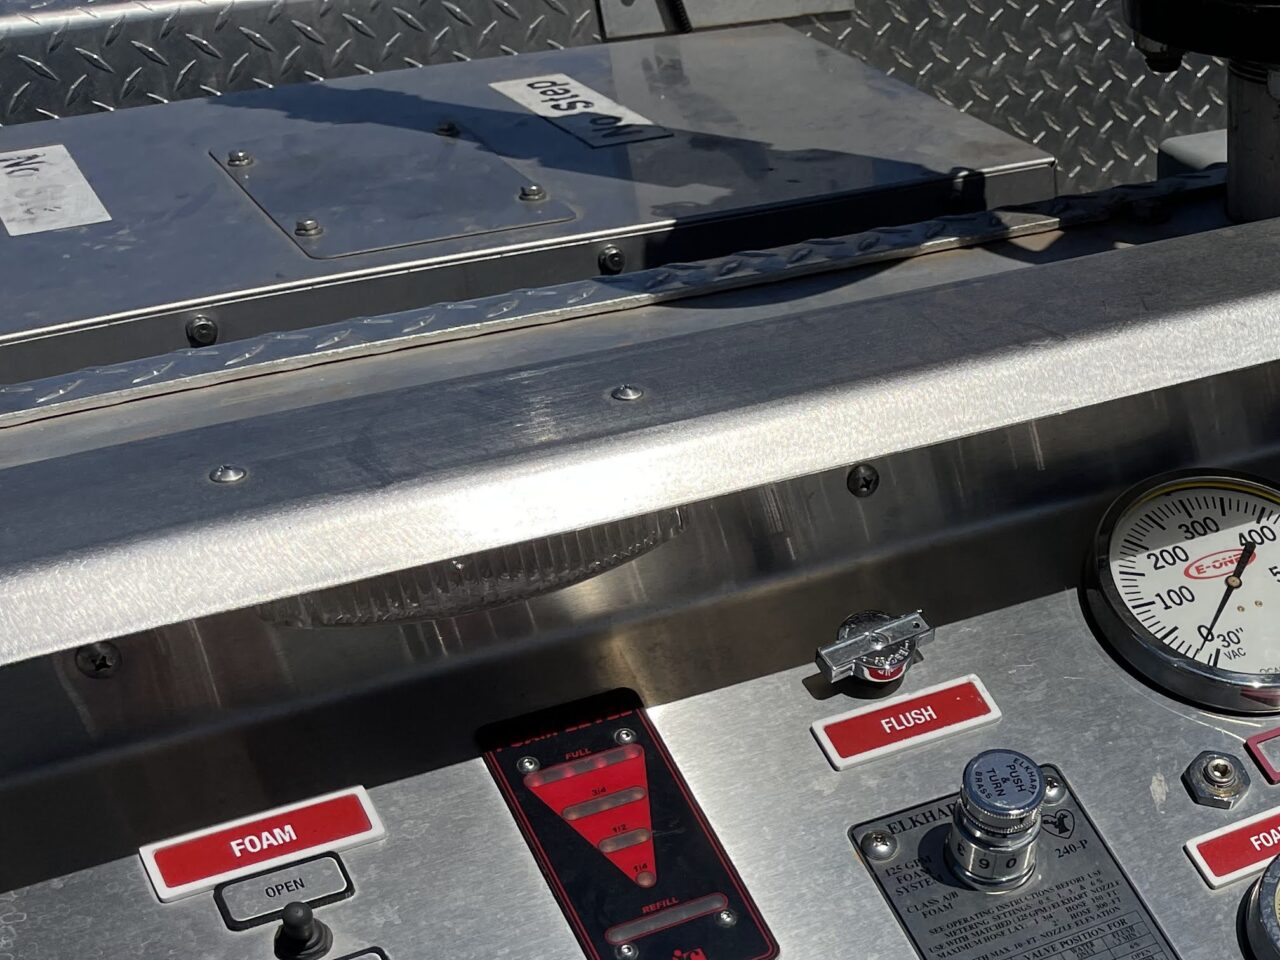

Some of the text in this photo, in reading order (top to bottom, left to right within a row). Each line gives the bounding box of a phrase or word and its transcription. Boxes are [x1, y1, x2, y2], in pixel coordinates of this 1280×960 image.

[527, 80, 643, 139] No Step
[1178, 516, 1220, 541] 300
[1238, 525, 1277, 548] 400
[1147, 545, 1190, 570] 200
[1155, 585, 1196, 611] 100
[1197, 624, 1214, 643] 0
[1217, 627, 1244, 648] 30"
[1224, 647, 1247, 661] VAC
[880, 705, 938, 733] FLUSH
[565, 748, 592, 760] FULL
[975, 771, 993, 800] BRASS
[986, 768, 1006, 797] TURN
[1001, 777, 1011, 785] &
[1006, 764, 1026, 792] PUSH
[1013, 757, 1034, 795] ELKHART
[230, 824, 297, 857] FOAM
[1054, 838, 1089, 859] 240-P
[885, 863, 903, 877] 125
[265, 878, 305, 898] OPEN
[641, 897, 679, 913] REFILL
[906, 900, 940, 915] CLASS
[921, 903, 954, 920] FOAM
[946, 906, 995, 932] OPERATING
[1059, 925, 1105, 950] POSITION
[1106, 917, 1128, 932] FOR
[937, 937, 984, 960] MAXIMUM
